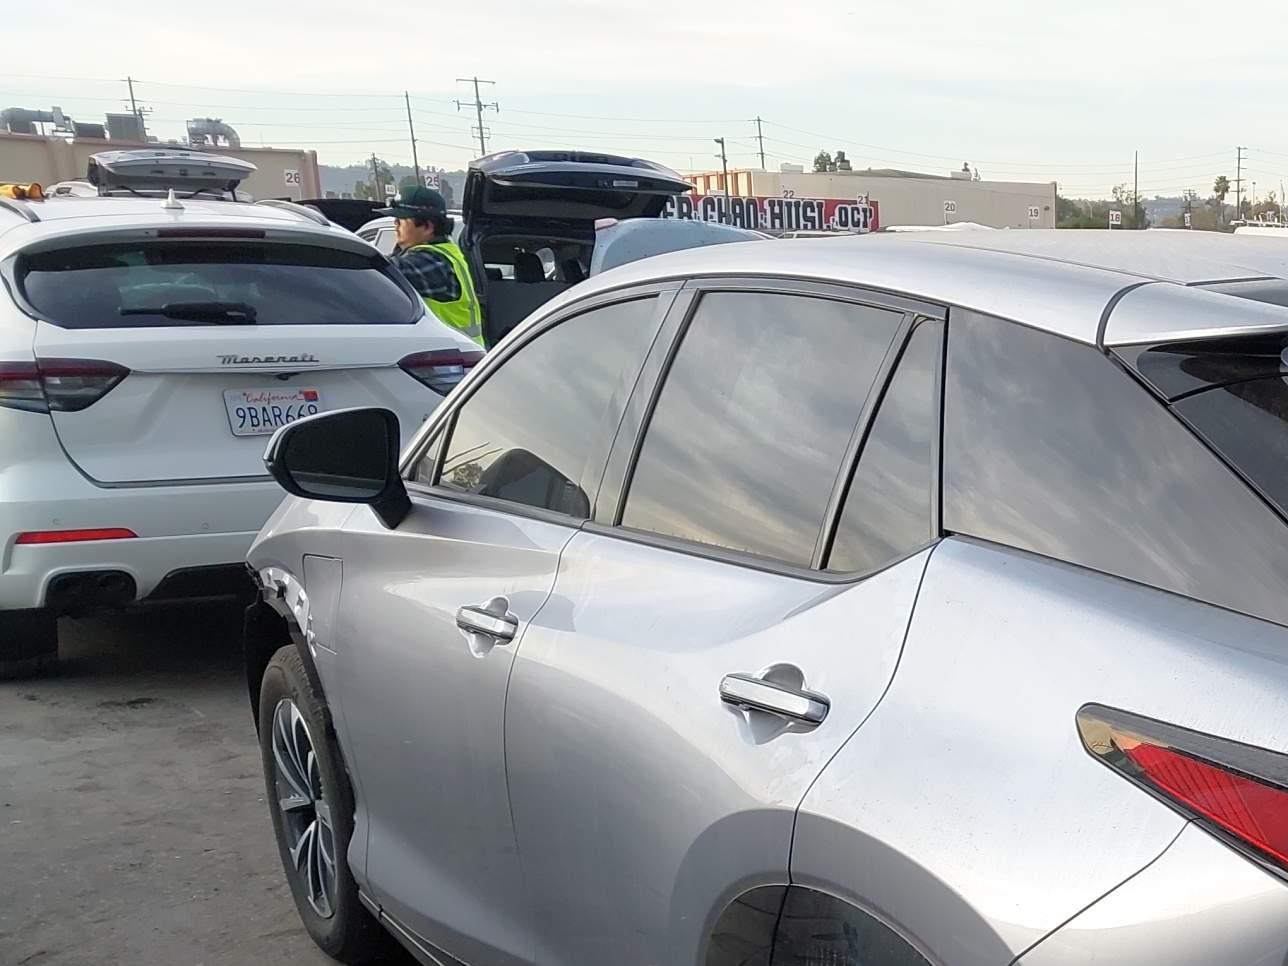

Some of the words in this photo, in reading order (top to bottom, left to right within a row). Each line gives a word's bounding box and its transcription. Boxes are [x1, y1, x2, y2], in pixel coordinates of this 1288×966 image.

[285, 172, 301, 184] 26
[426, 176, 440, 187] 25
[783, 190, 795, 199] 22
[944, 202, 956, 212] 20
[1028, 208, 1039, 217] 19
[215, 352, 320, 365] Maserati
